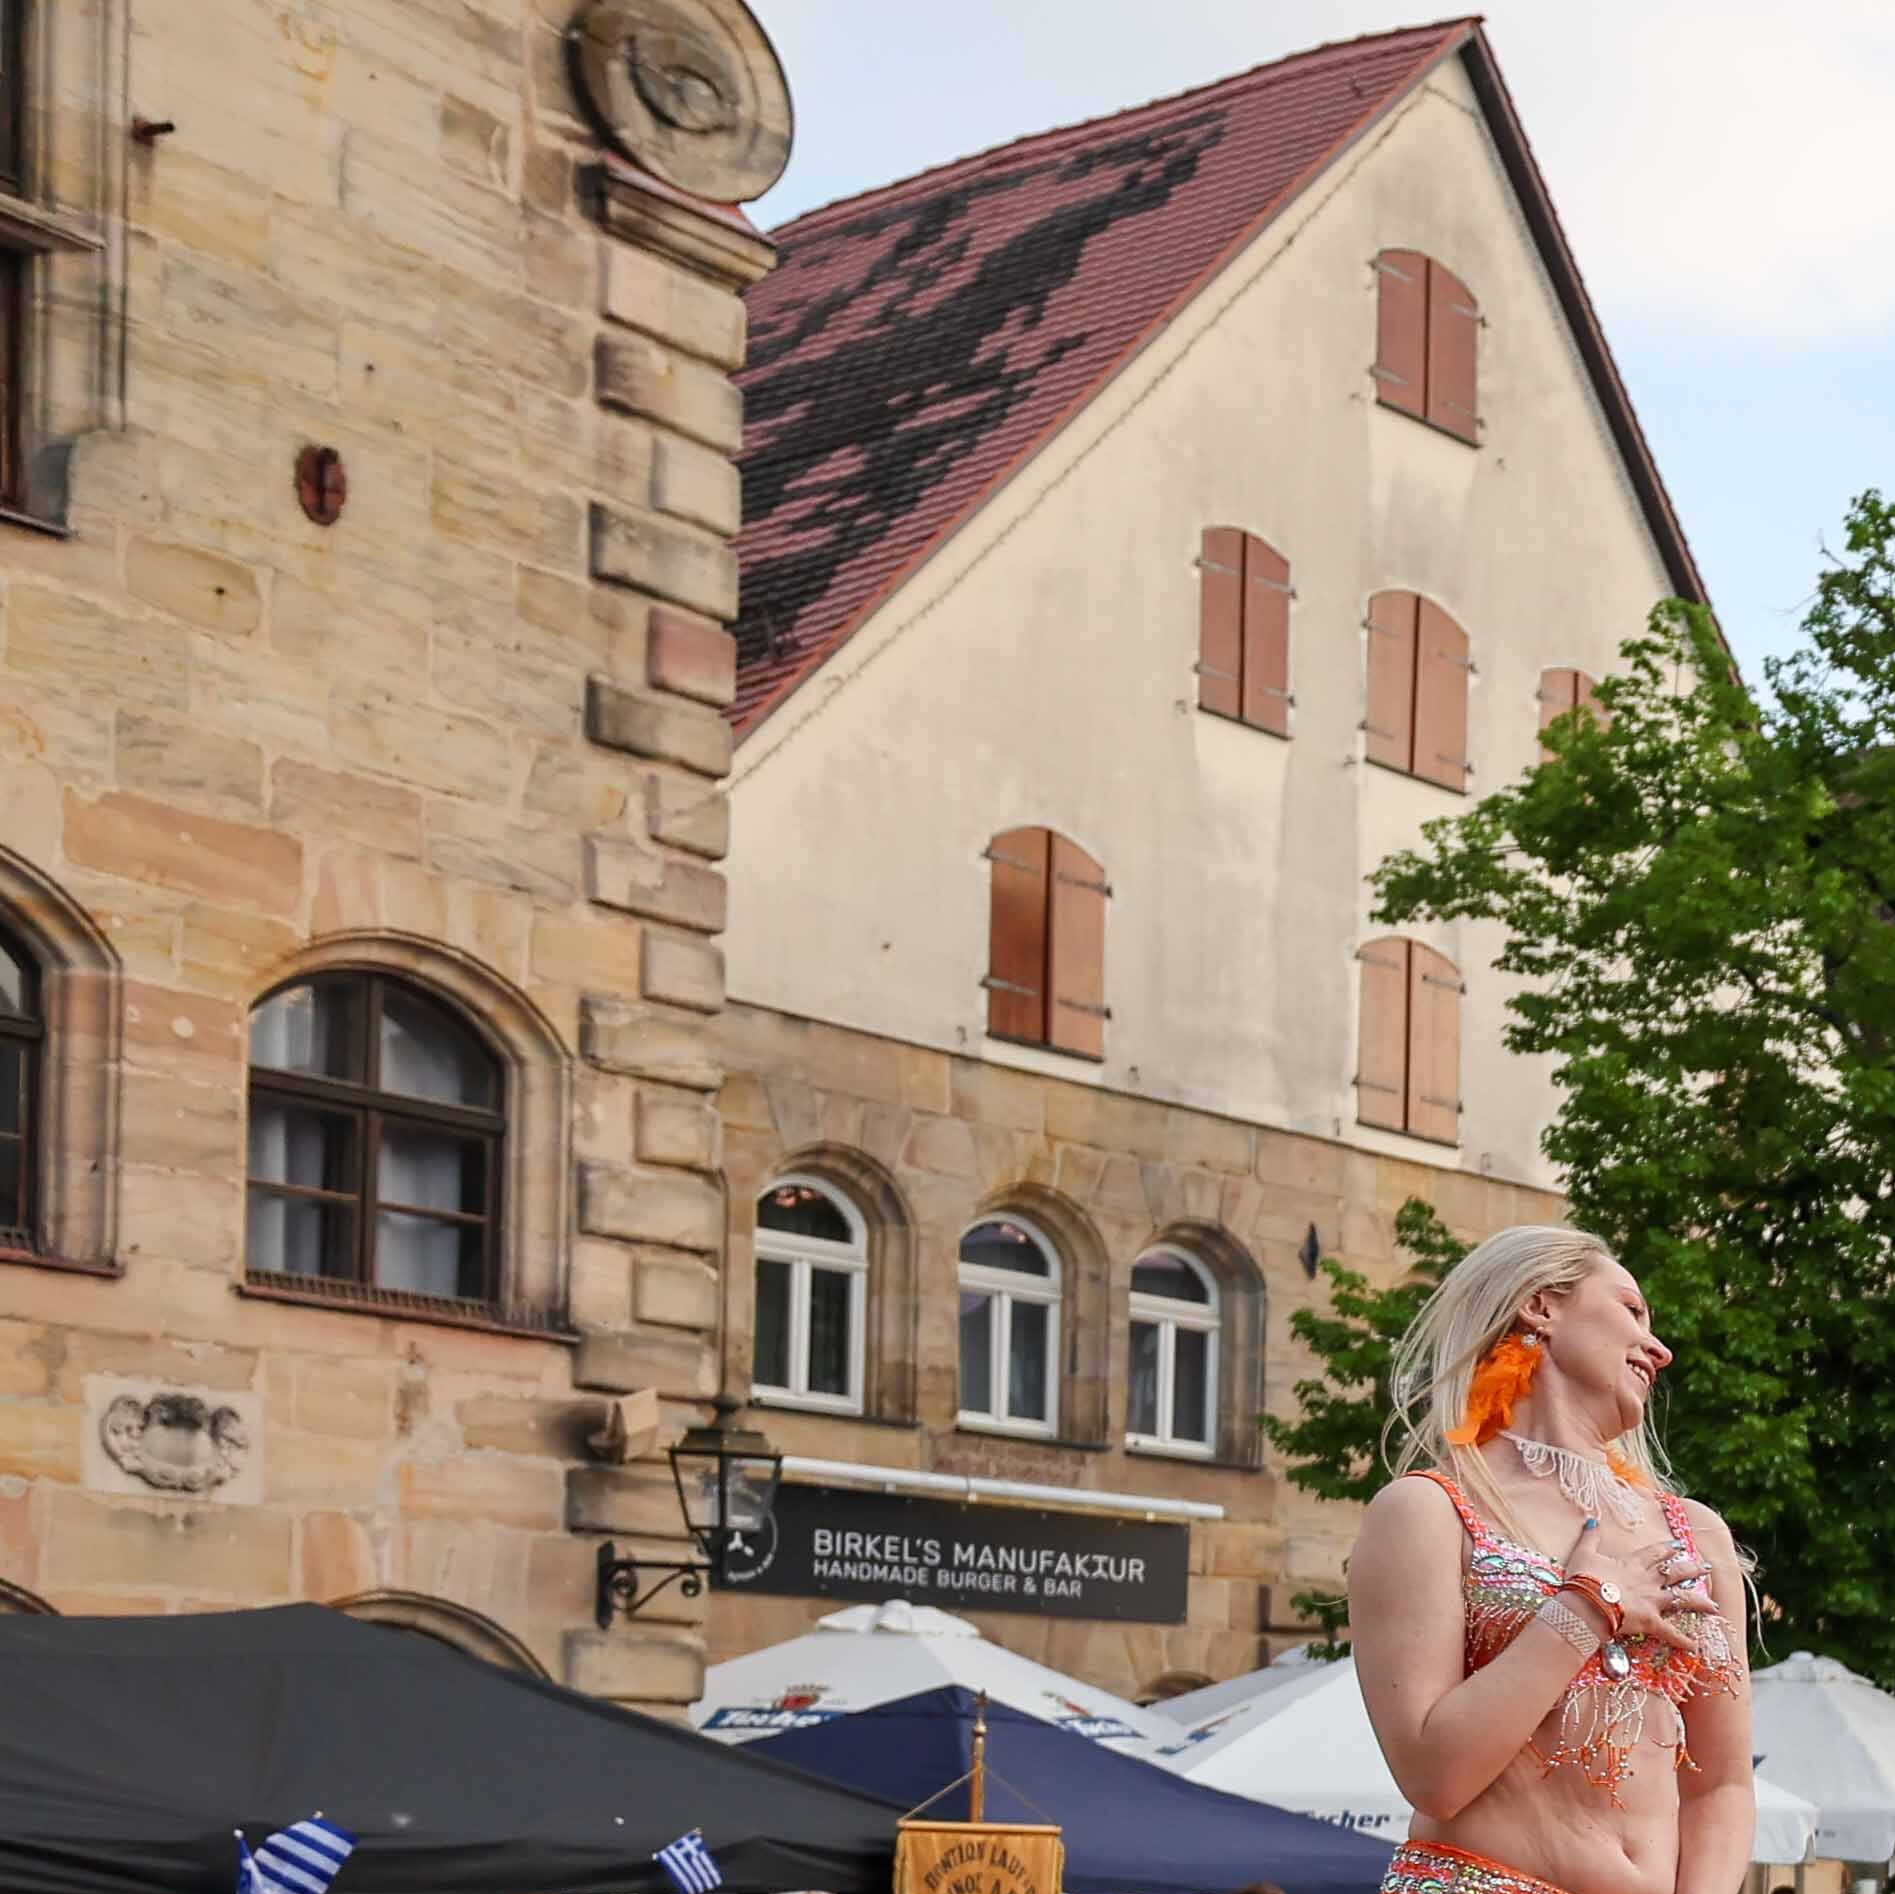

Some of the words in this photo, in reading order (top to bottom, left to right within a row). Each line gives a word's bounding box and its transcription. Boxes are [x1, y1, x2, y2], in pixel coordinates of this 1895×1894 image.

[813, 1527, 941, 1566] BIRKEL'S
[953, 1542, 1146, 1583] MANUFAKTUR
[813, 1559, 929, 1588] HANDMADE
[937, 1569, 1017, 1593] BURGER
[1023, 1576, 1037, 1595] &
[1043, 1579, 1082, 1598] BAR
